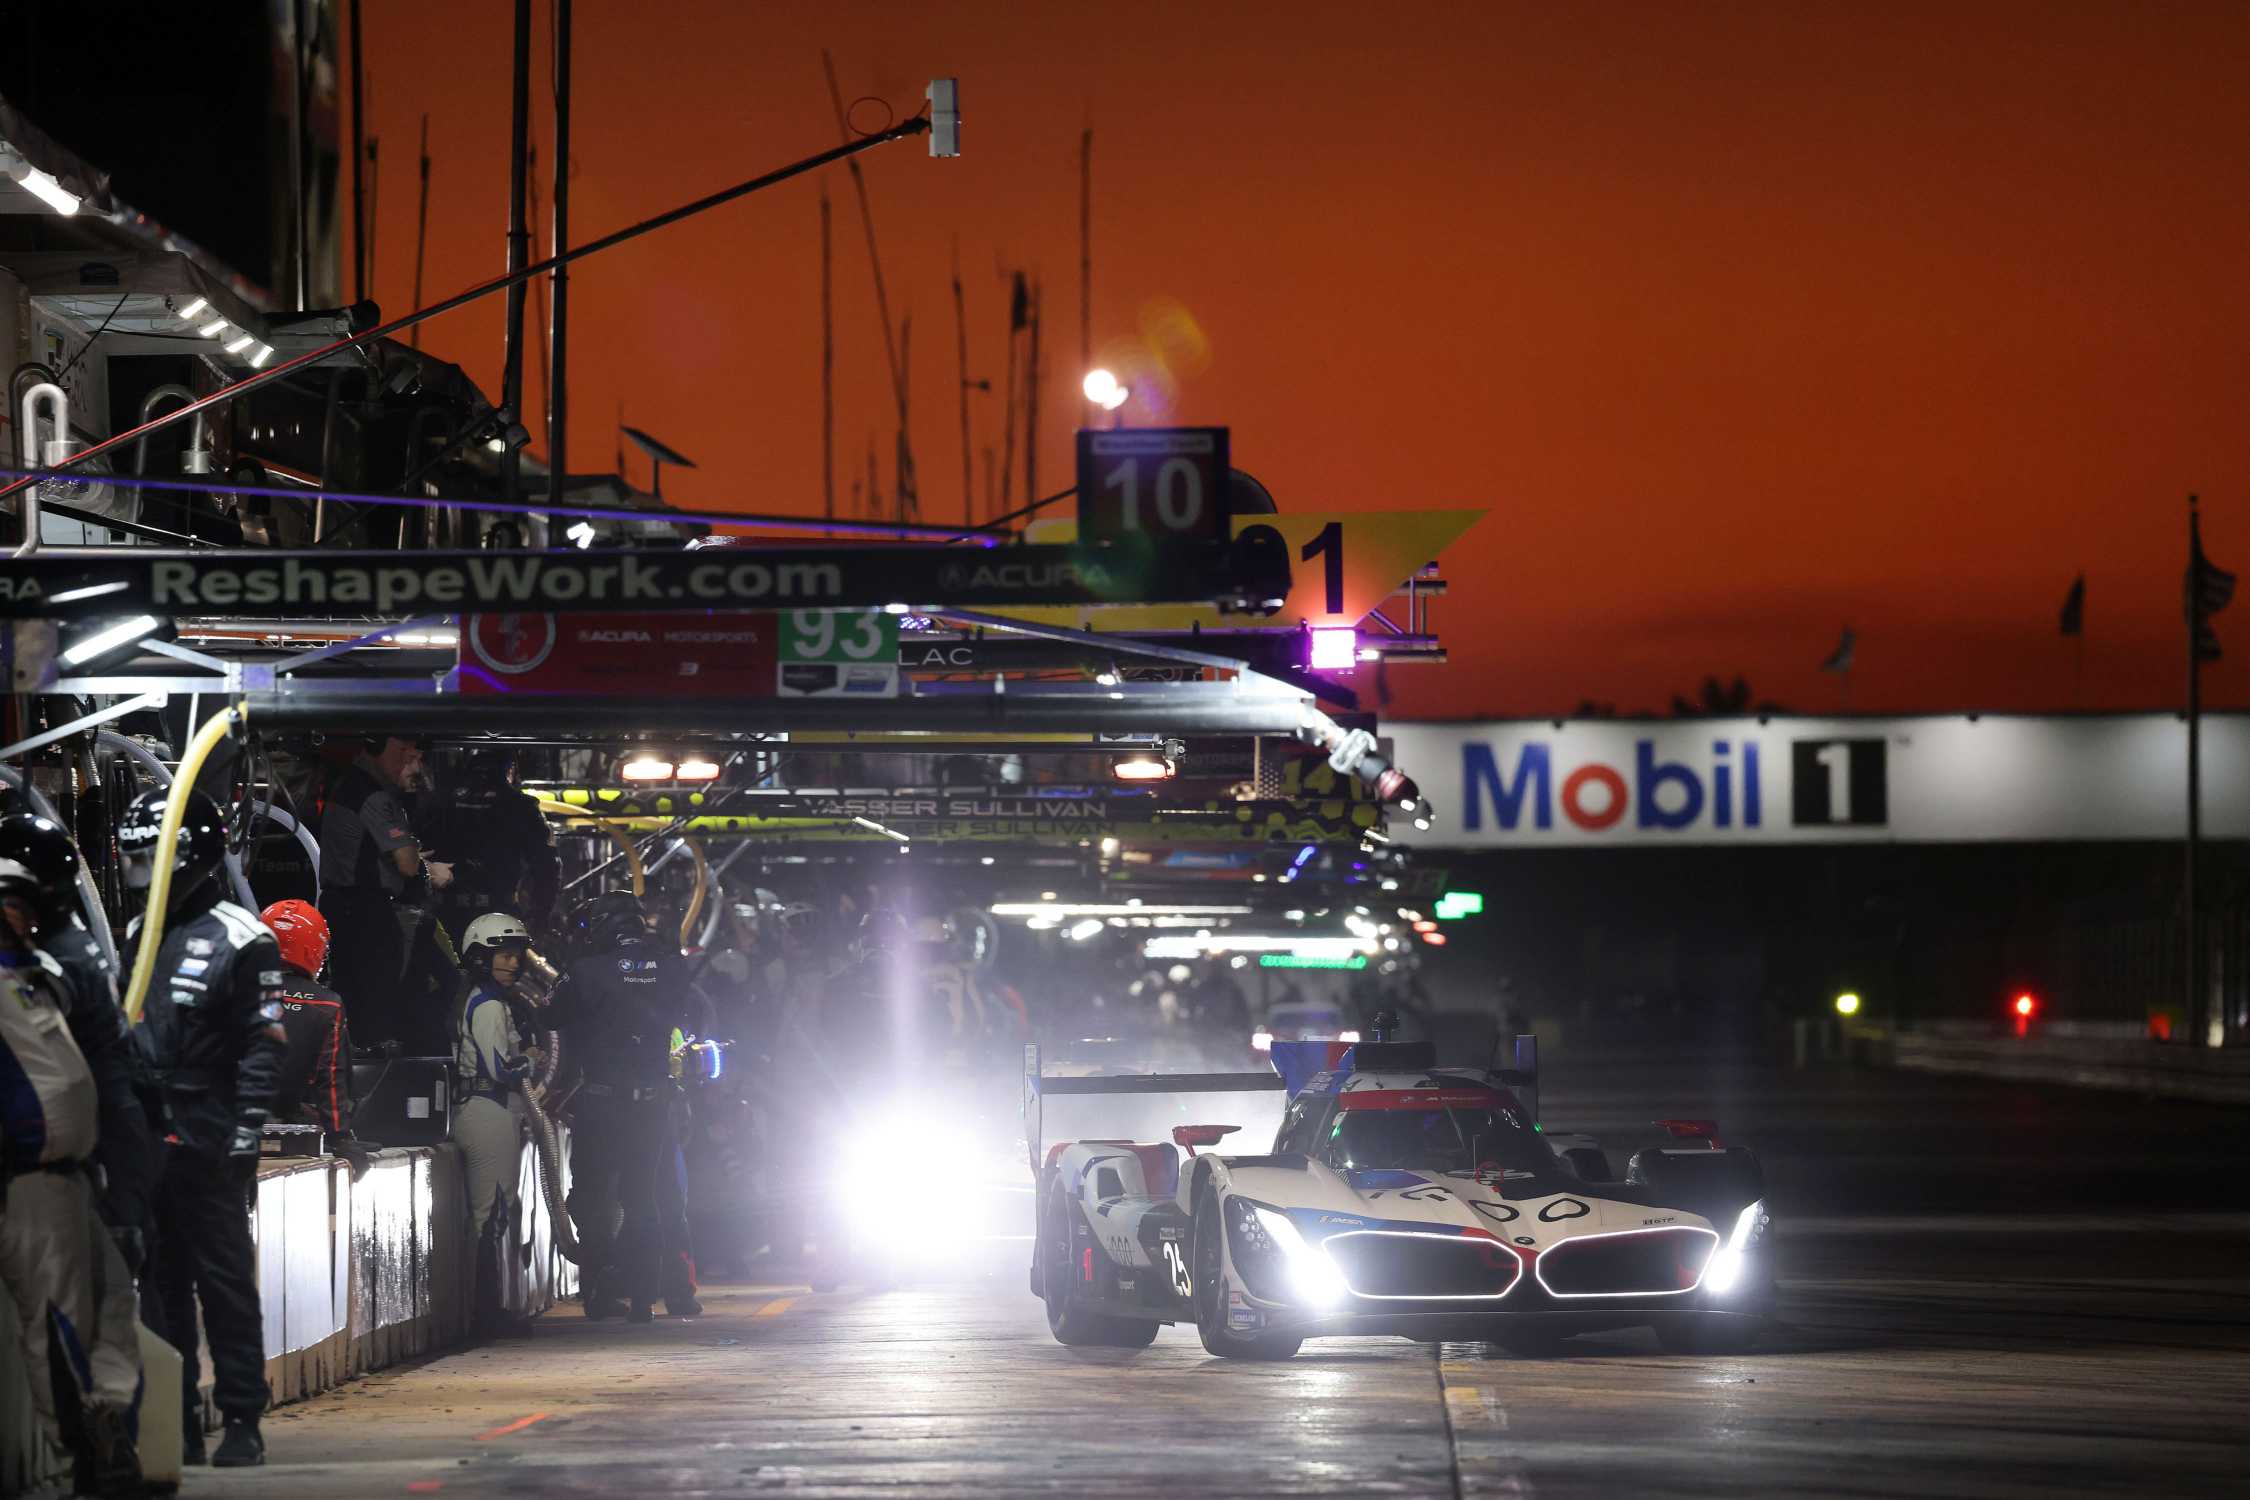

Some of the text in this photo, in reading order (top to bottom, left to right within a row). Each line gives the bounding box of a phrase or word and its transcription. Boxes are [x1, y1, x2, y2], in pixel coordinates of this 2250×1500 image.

[1103, 457, 1203, 531] 10
[150, 557, 842, 612] ReshapeWork.com
[970, 564, 1113, 588] ACURA
[792, 609, 883, 659] 93
[950, 802, 1106, 818] SULLIVAN
[1462, 741, 1852, 830] Mobil 1
